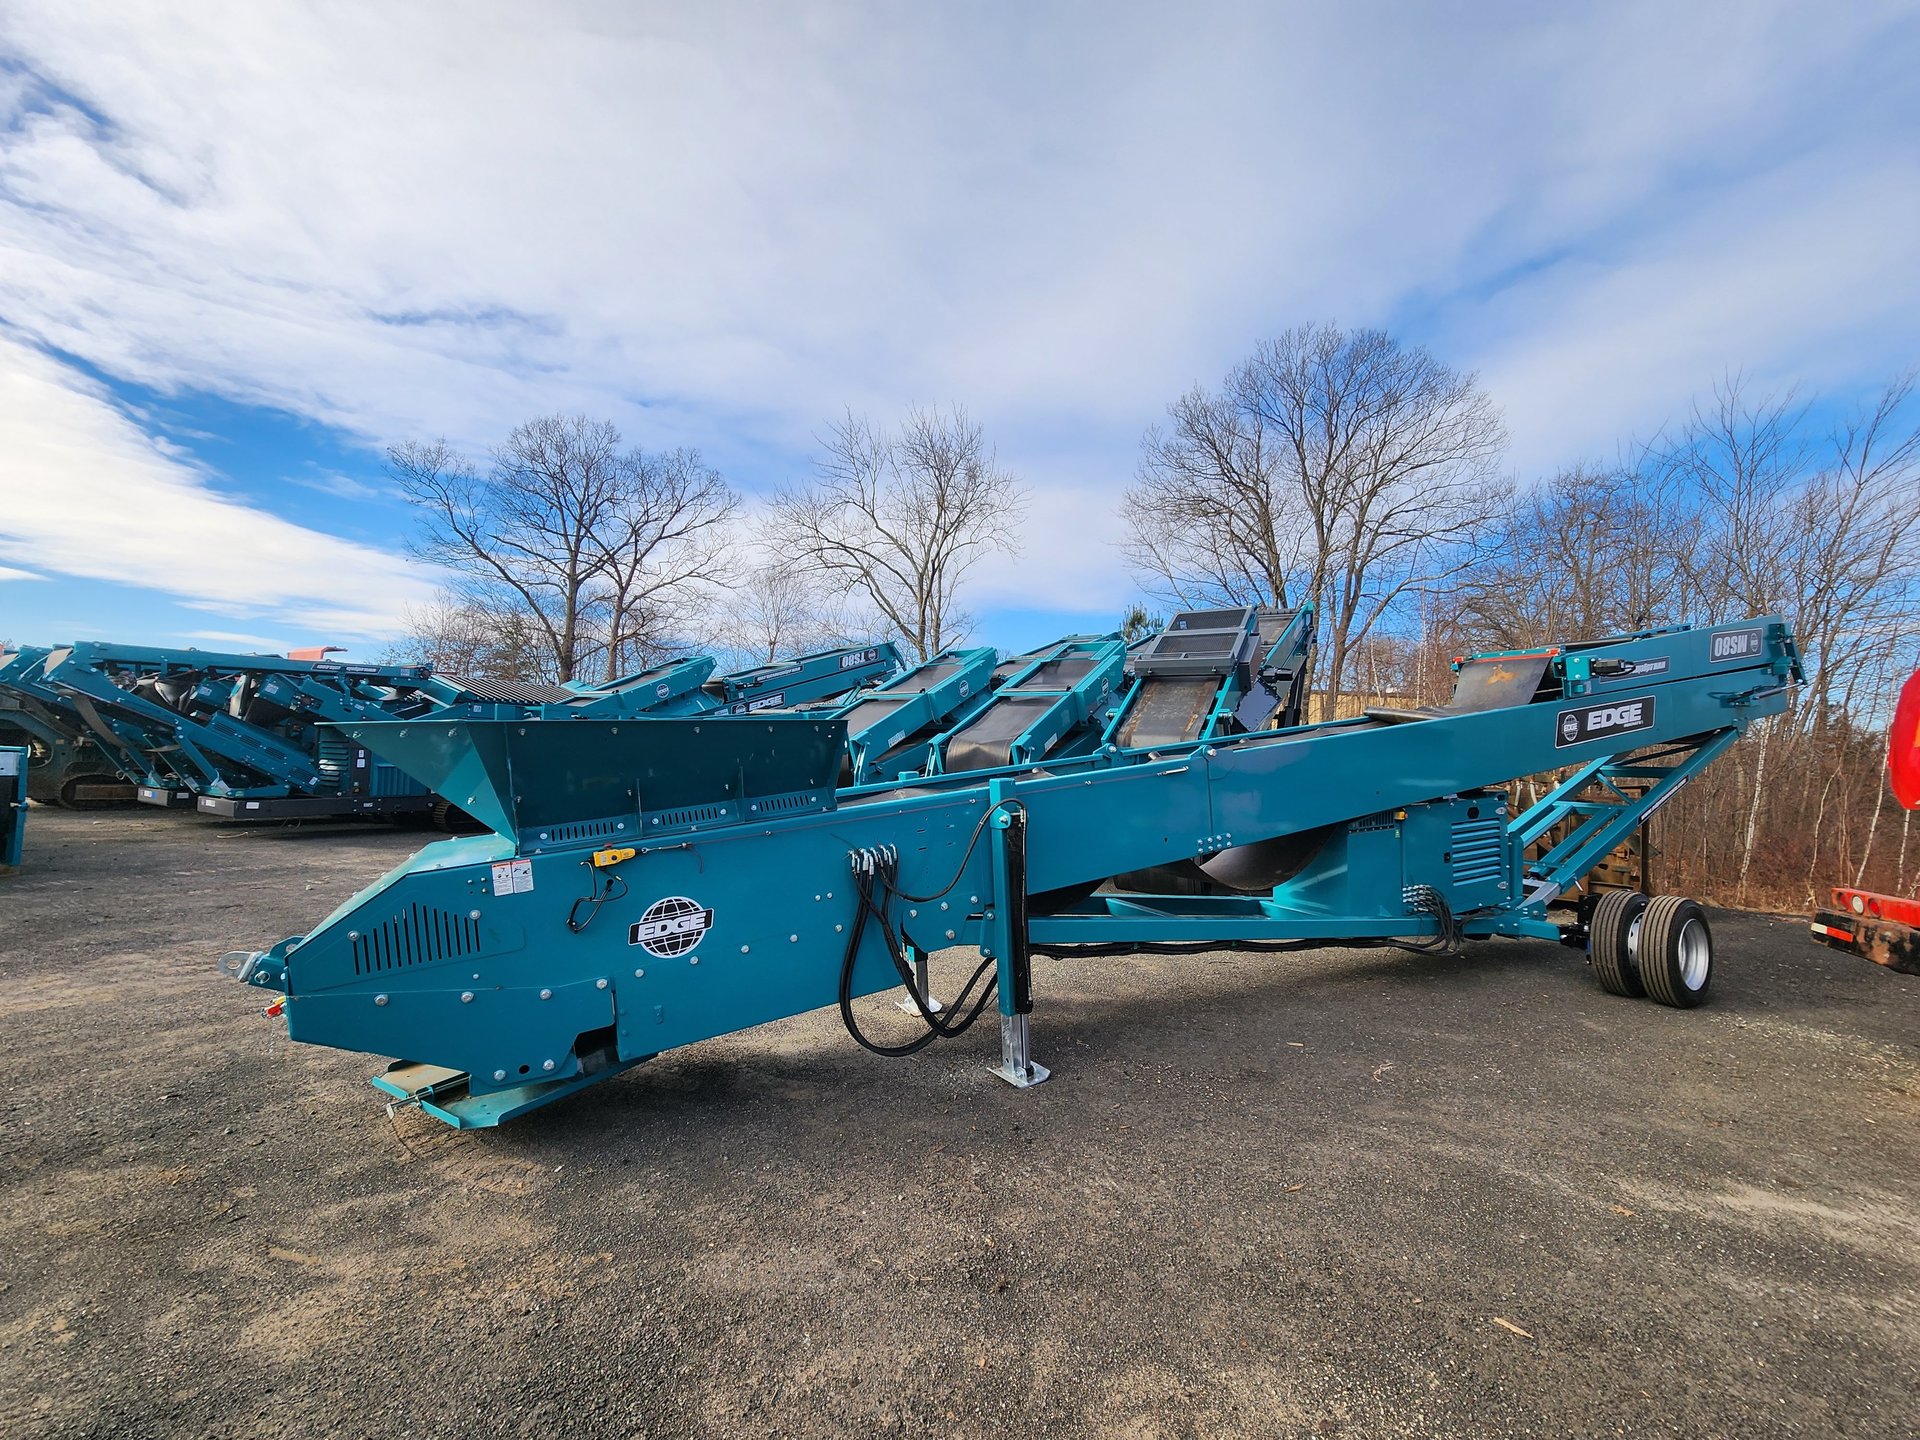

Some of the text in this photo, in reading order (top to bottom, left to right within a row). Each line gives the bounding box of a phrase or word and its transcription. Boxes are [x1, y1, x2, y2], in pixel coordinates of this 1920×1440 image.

[749, 695, 783, 711] EDGE
[1587, 702, 1643, 731] EDGE
[638, 911, 707, 942] EDGE
